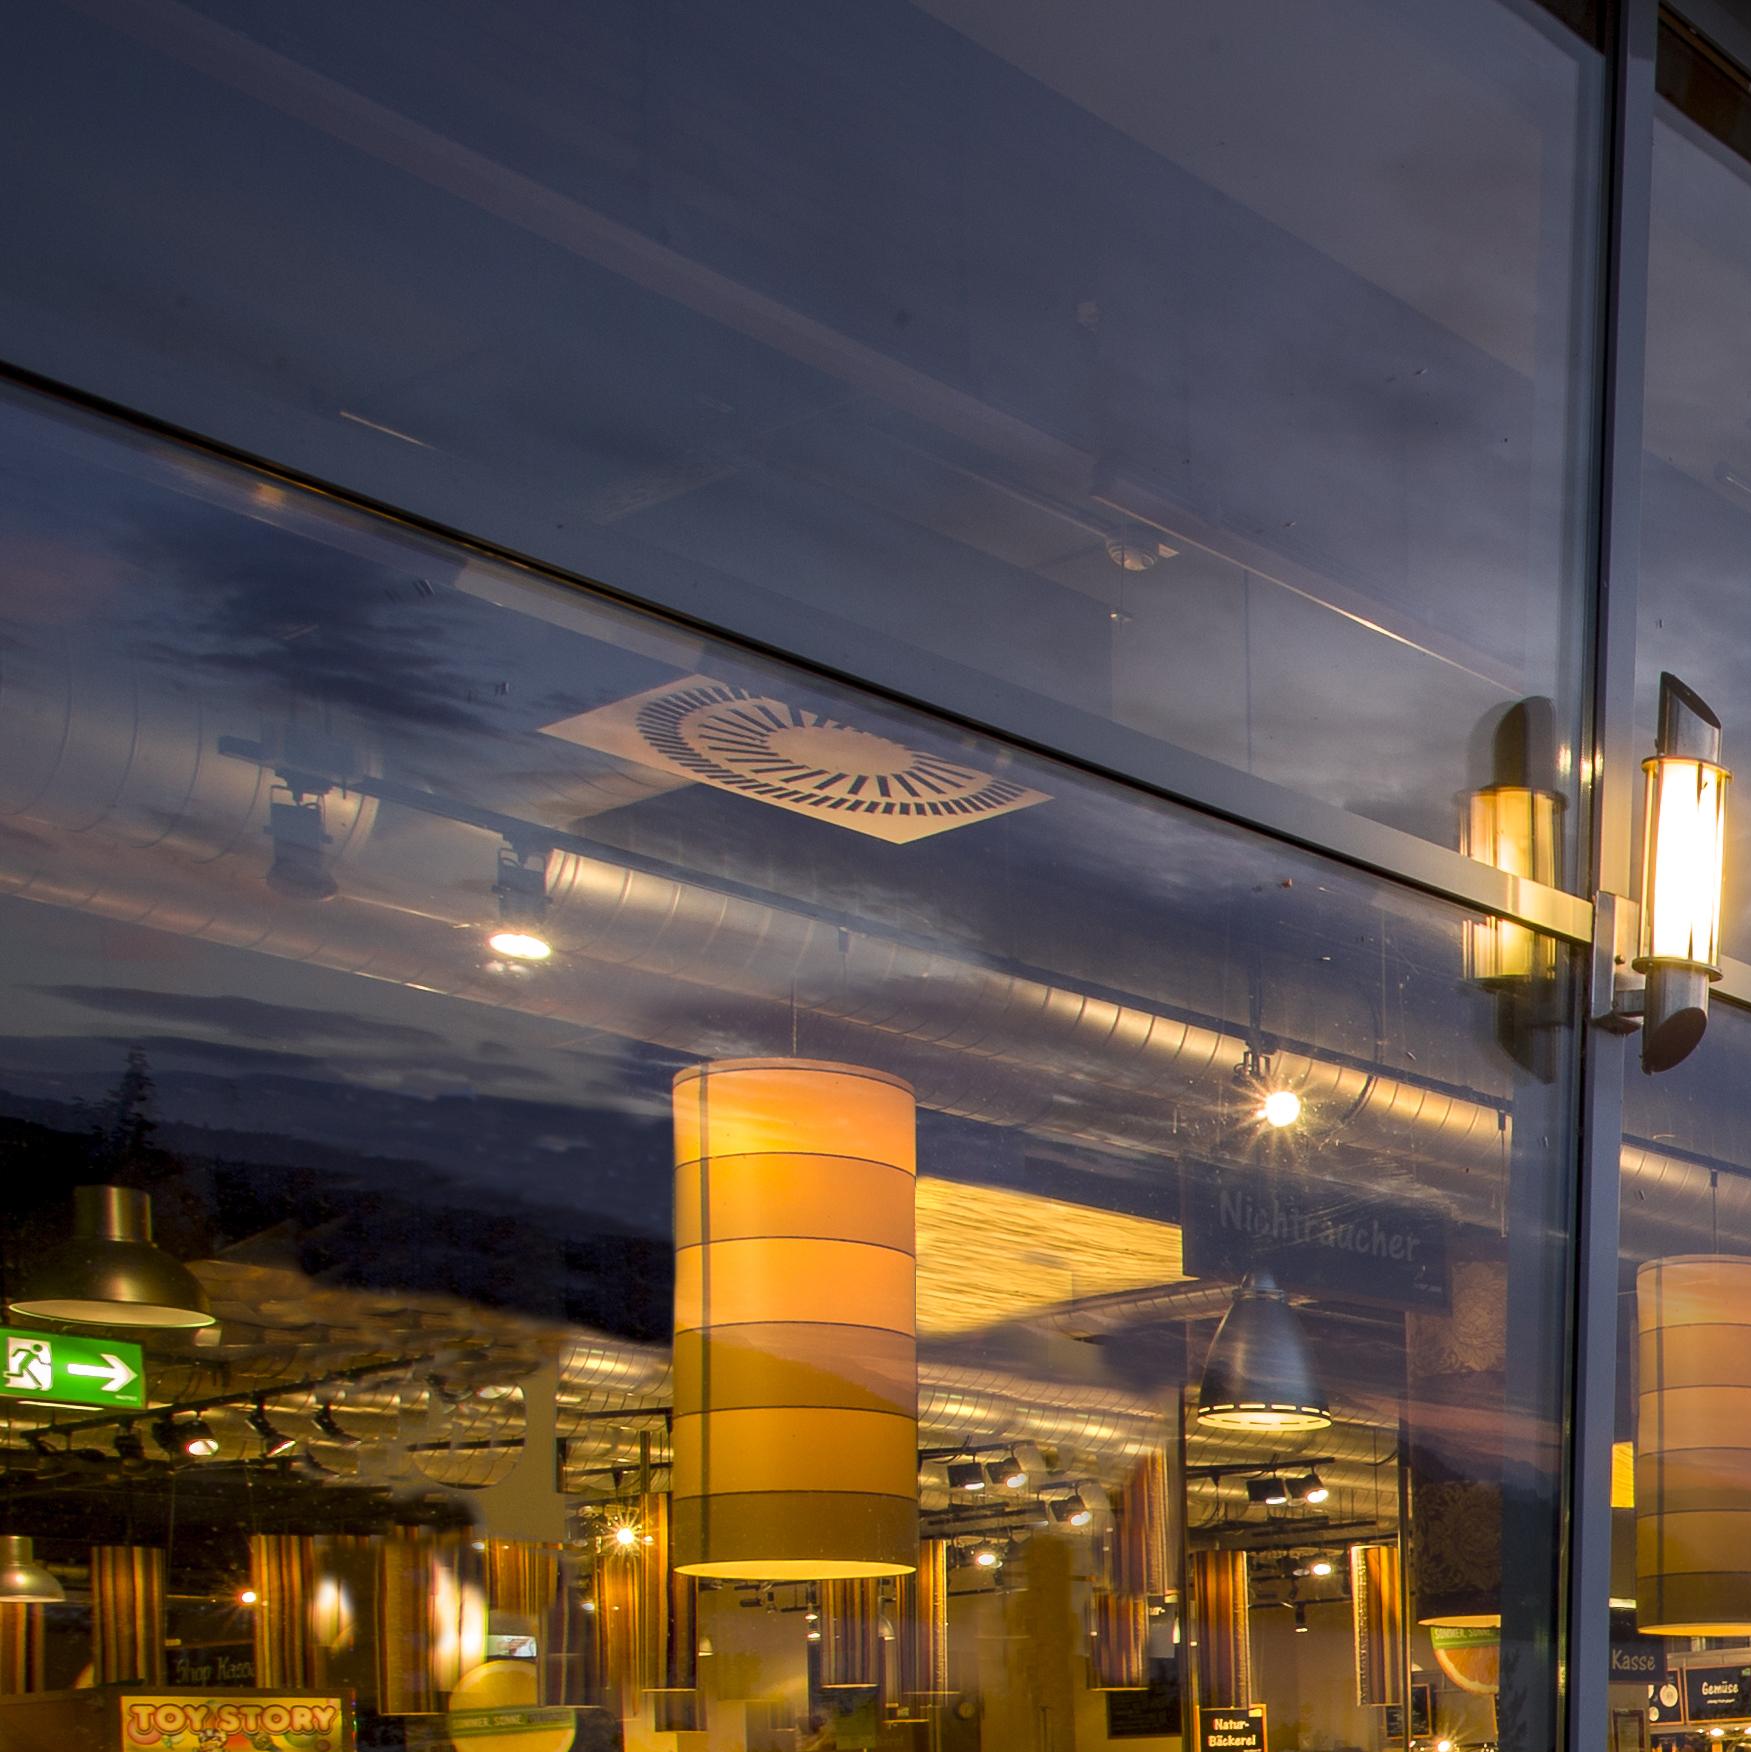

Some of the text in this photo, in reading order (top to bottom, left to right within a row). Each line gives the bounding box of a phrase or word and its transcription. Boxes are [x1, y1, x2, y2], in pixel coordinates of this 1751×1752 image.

[1611, 1649, 1656, 1671] Kasse
[1701, 1680, 1739, 1696] Gemüse
[129, 1704, 337, 1736] TOY STORY
[1213, 1718, 1250, 1731] Natur-
[1207, 1734, 1257, 1748] Bäckerei
